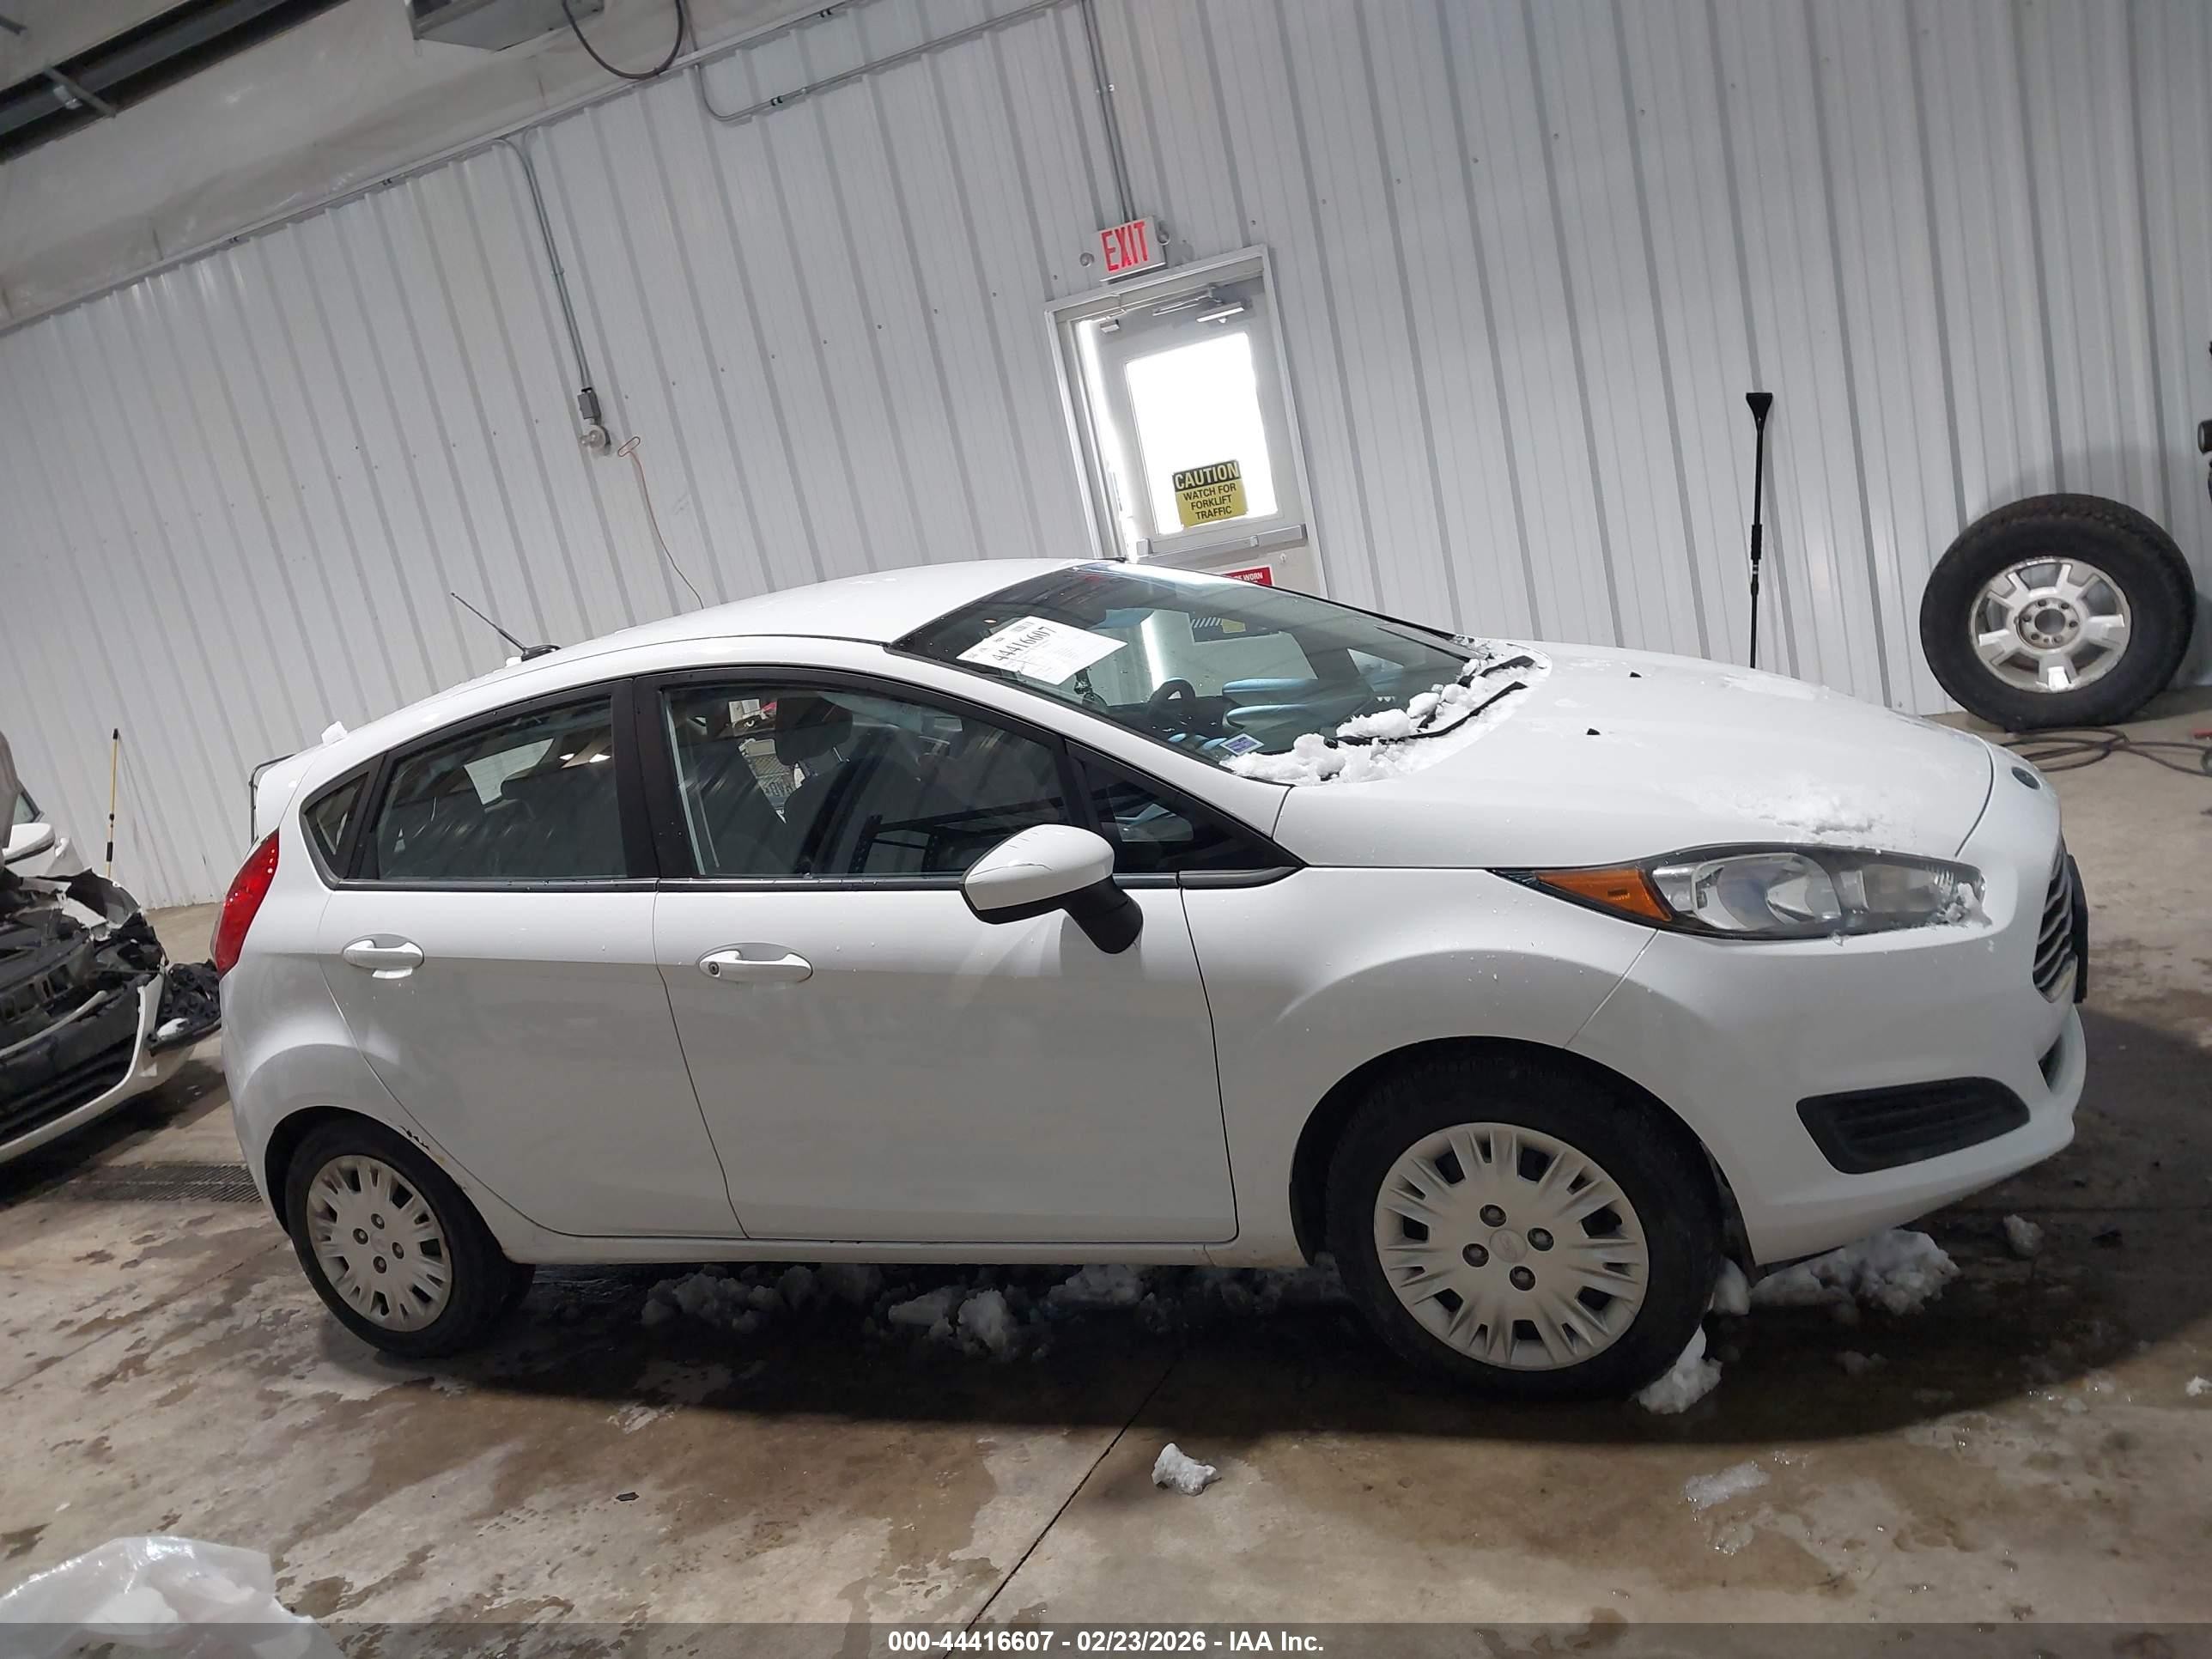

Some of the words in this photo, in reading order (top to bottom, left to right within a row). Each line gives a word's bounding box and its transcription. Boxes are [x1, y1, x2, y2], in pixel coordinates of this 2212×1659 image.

[1100, 221, 1148, 272] EXIT
[1175, 461, 1239, 489] CAUTION
[1183, 487, 1216, 501] WATCH
[1218, 483, 1237, 495] FOR
[1191, 495, 1231, 510] FORKLIFT
[1195, 506, 1232, 520] TRAFFIC
[992, 626, 1056, 661] 44416607
